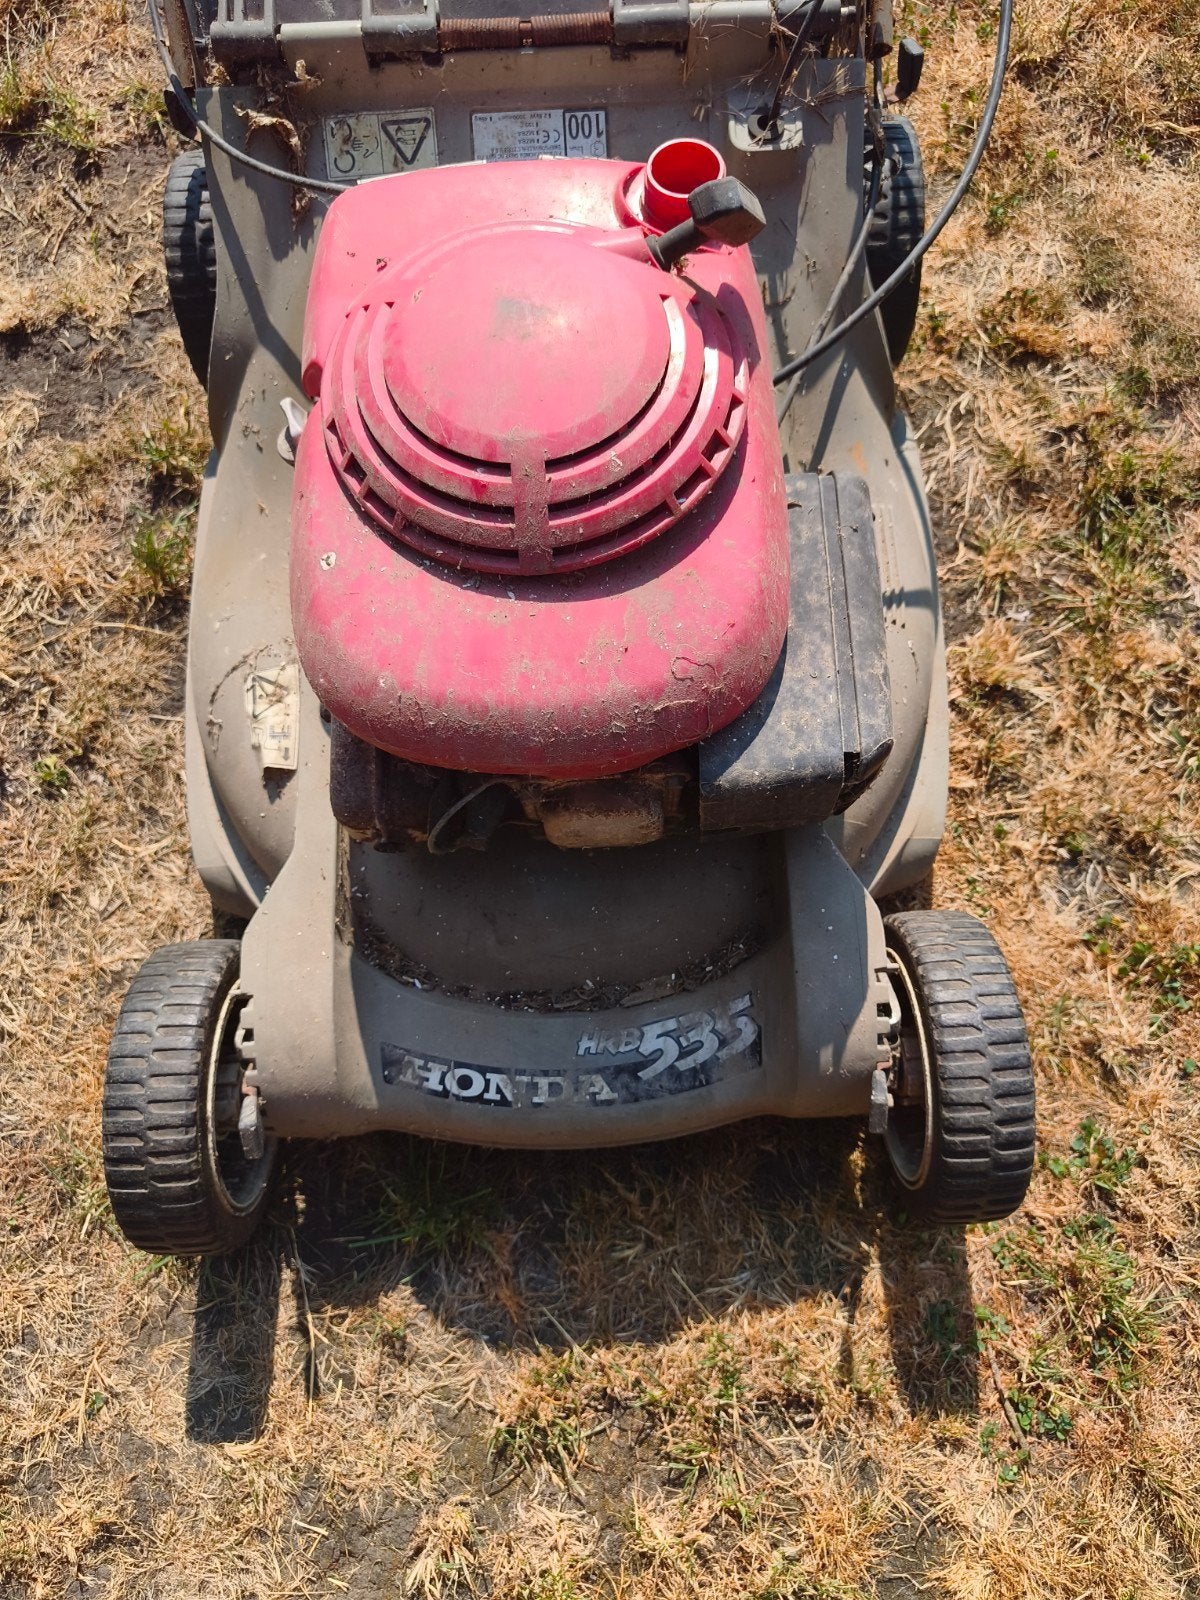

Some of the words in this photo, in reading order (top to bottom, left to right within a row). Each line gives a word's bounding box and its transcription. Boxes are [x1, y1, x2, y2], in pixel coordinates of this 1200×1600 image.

[568, 113, 604, 140] 100
[637, 992, 757, 1081] 535
[403, 1055, 619, 1104] HONDA
